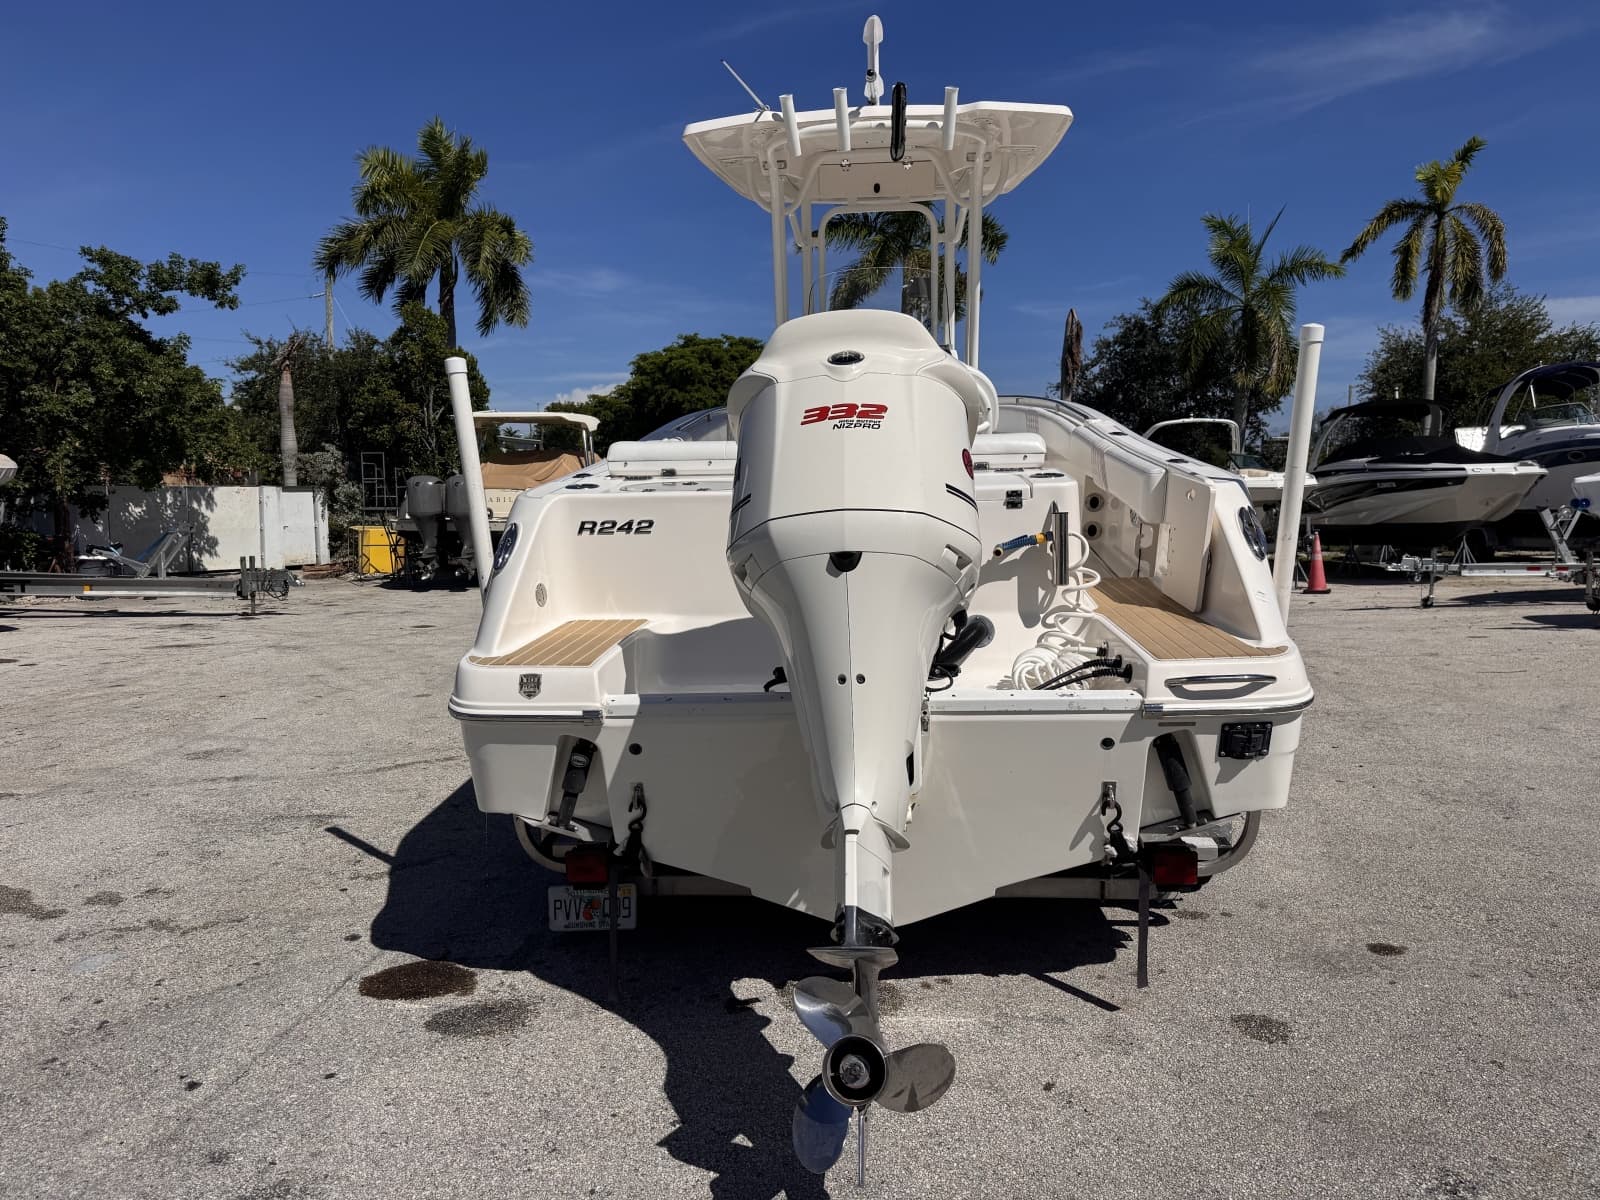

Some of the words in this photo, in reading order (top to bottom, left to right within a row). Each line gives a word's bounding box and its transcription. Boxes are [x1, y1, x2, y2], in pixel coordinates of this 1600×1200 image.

[800, 403, 888, 425] 332
[577, 519, 655, 536] R242
[553, 898, 582, 921] PVV
